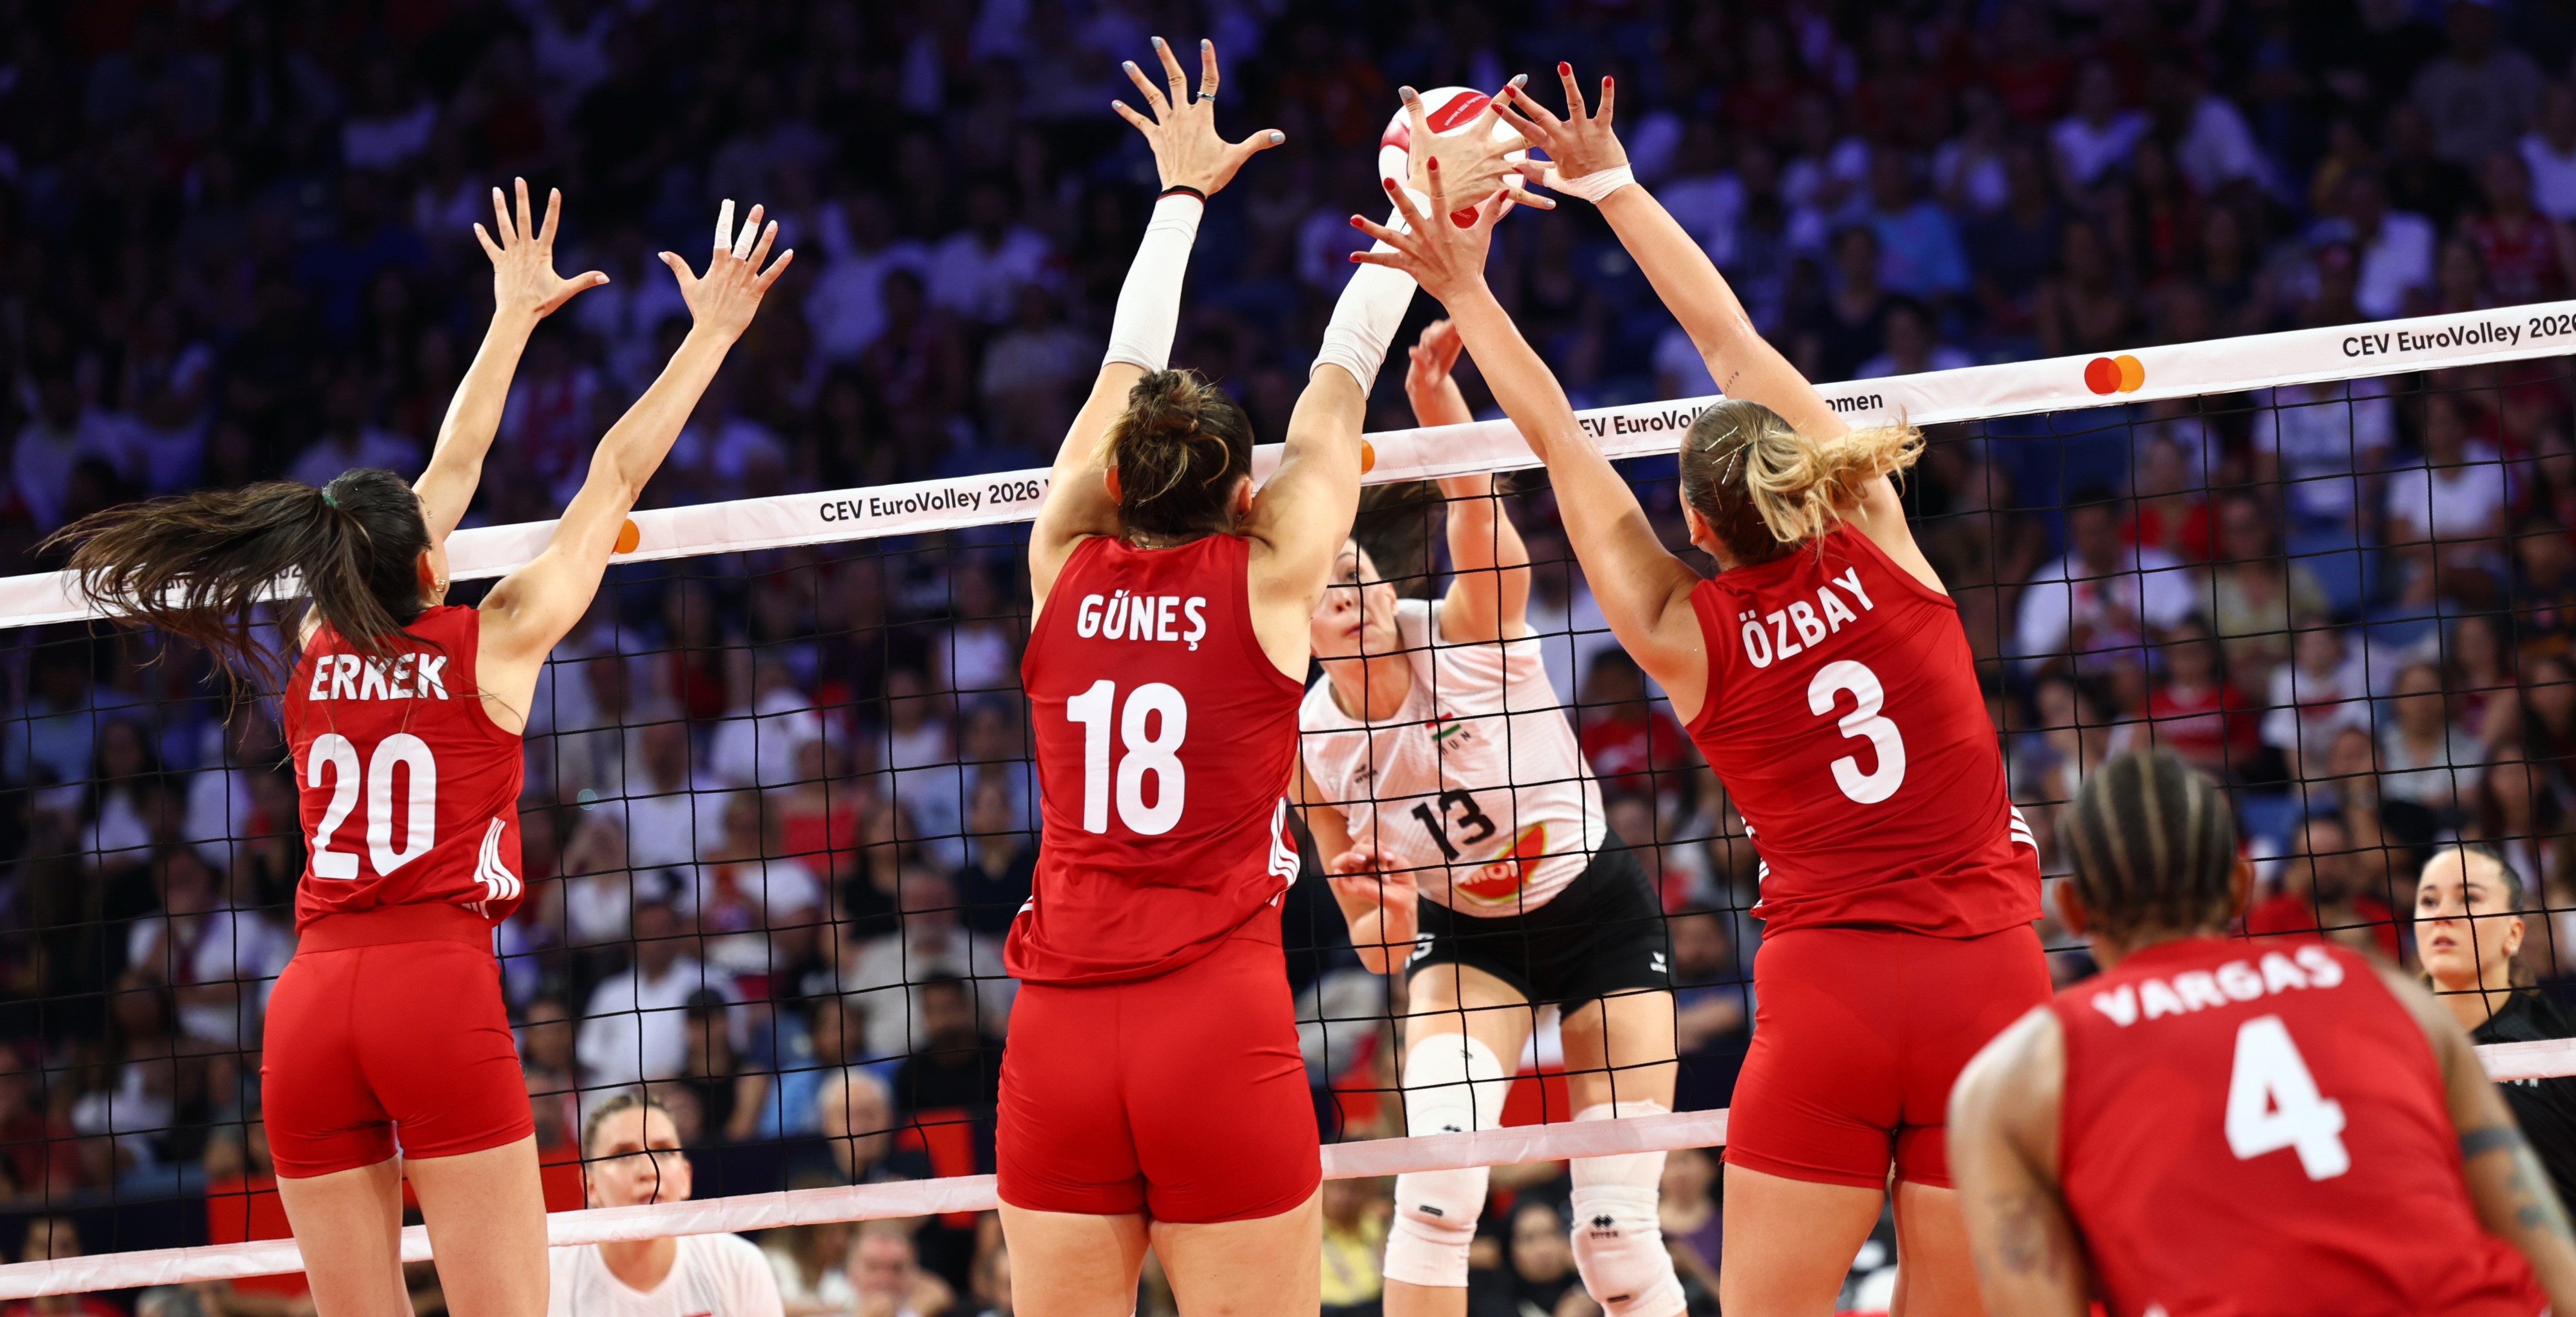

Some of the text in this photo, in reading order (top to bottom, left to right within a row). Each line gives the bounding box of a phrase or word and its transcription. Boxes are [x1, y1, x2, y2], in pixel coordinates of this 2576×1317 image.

[2343, 333, 2389, 357] CEV
[2398, 321, 2521, 352] EuroVolley
[1579, 417, 1606, 438] EV
[1825, 394, 1883, 412] omen
[820, 499, 862, 522] CEV
[870, 488, 981, 516] EuroVolley
[988, 480, 1040, 504] 2026
[1077, 589, 1207, 651] GÜNEŞ
[1739, 566, 1873, 669] ÖZBAY
[308, 653, 449, 701] ERKEK
[1066, 679, 1187, 835] 18
[1807, 660, 1906, 804] 3
[307, 733, 437, 880] 20
[1411, 789, 1496, 861] 13
[2091, 945, 2344, 1028] VARGAS
[2224, 1014, 2351, 1181] 4
